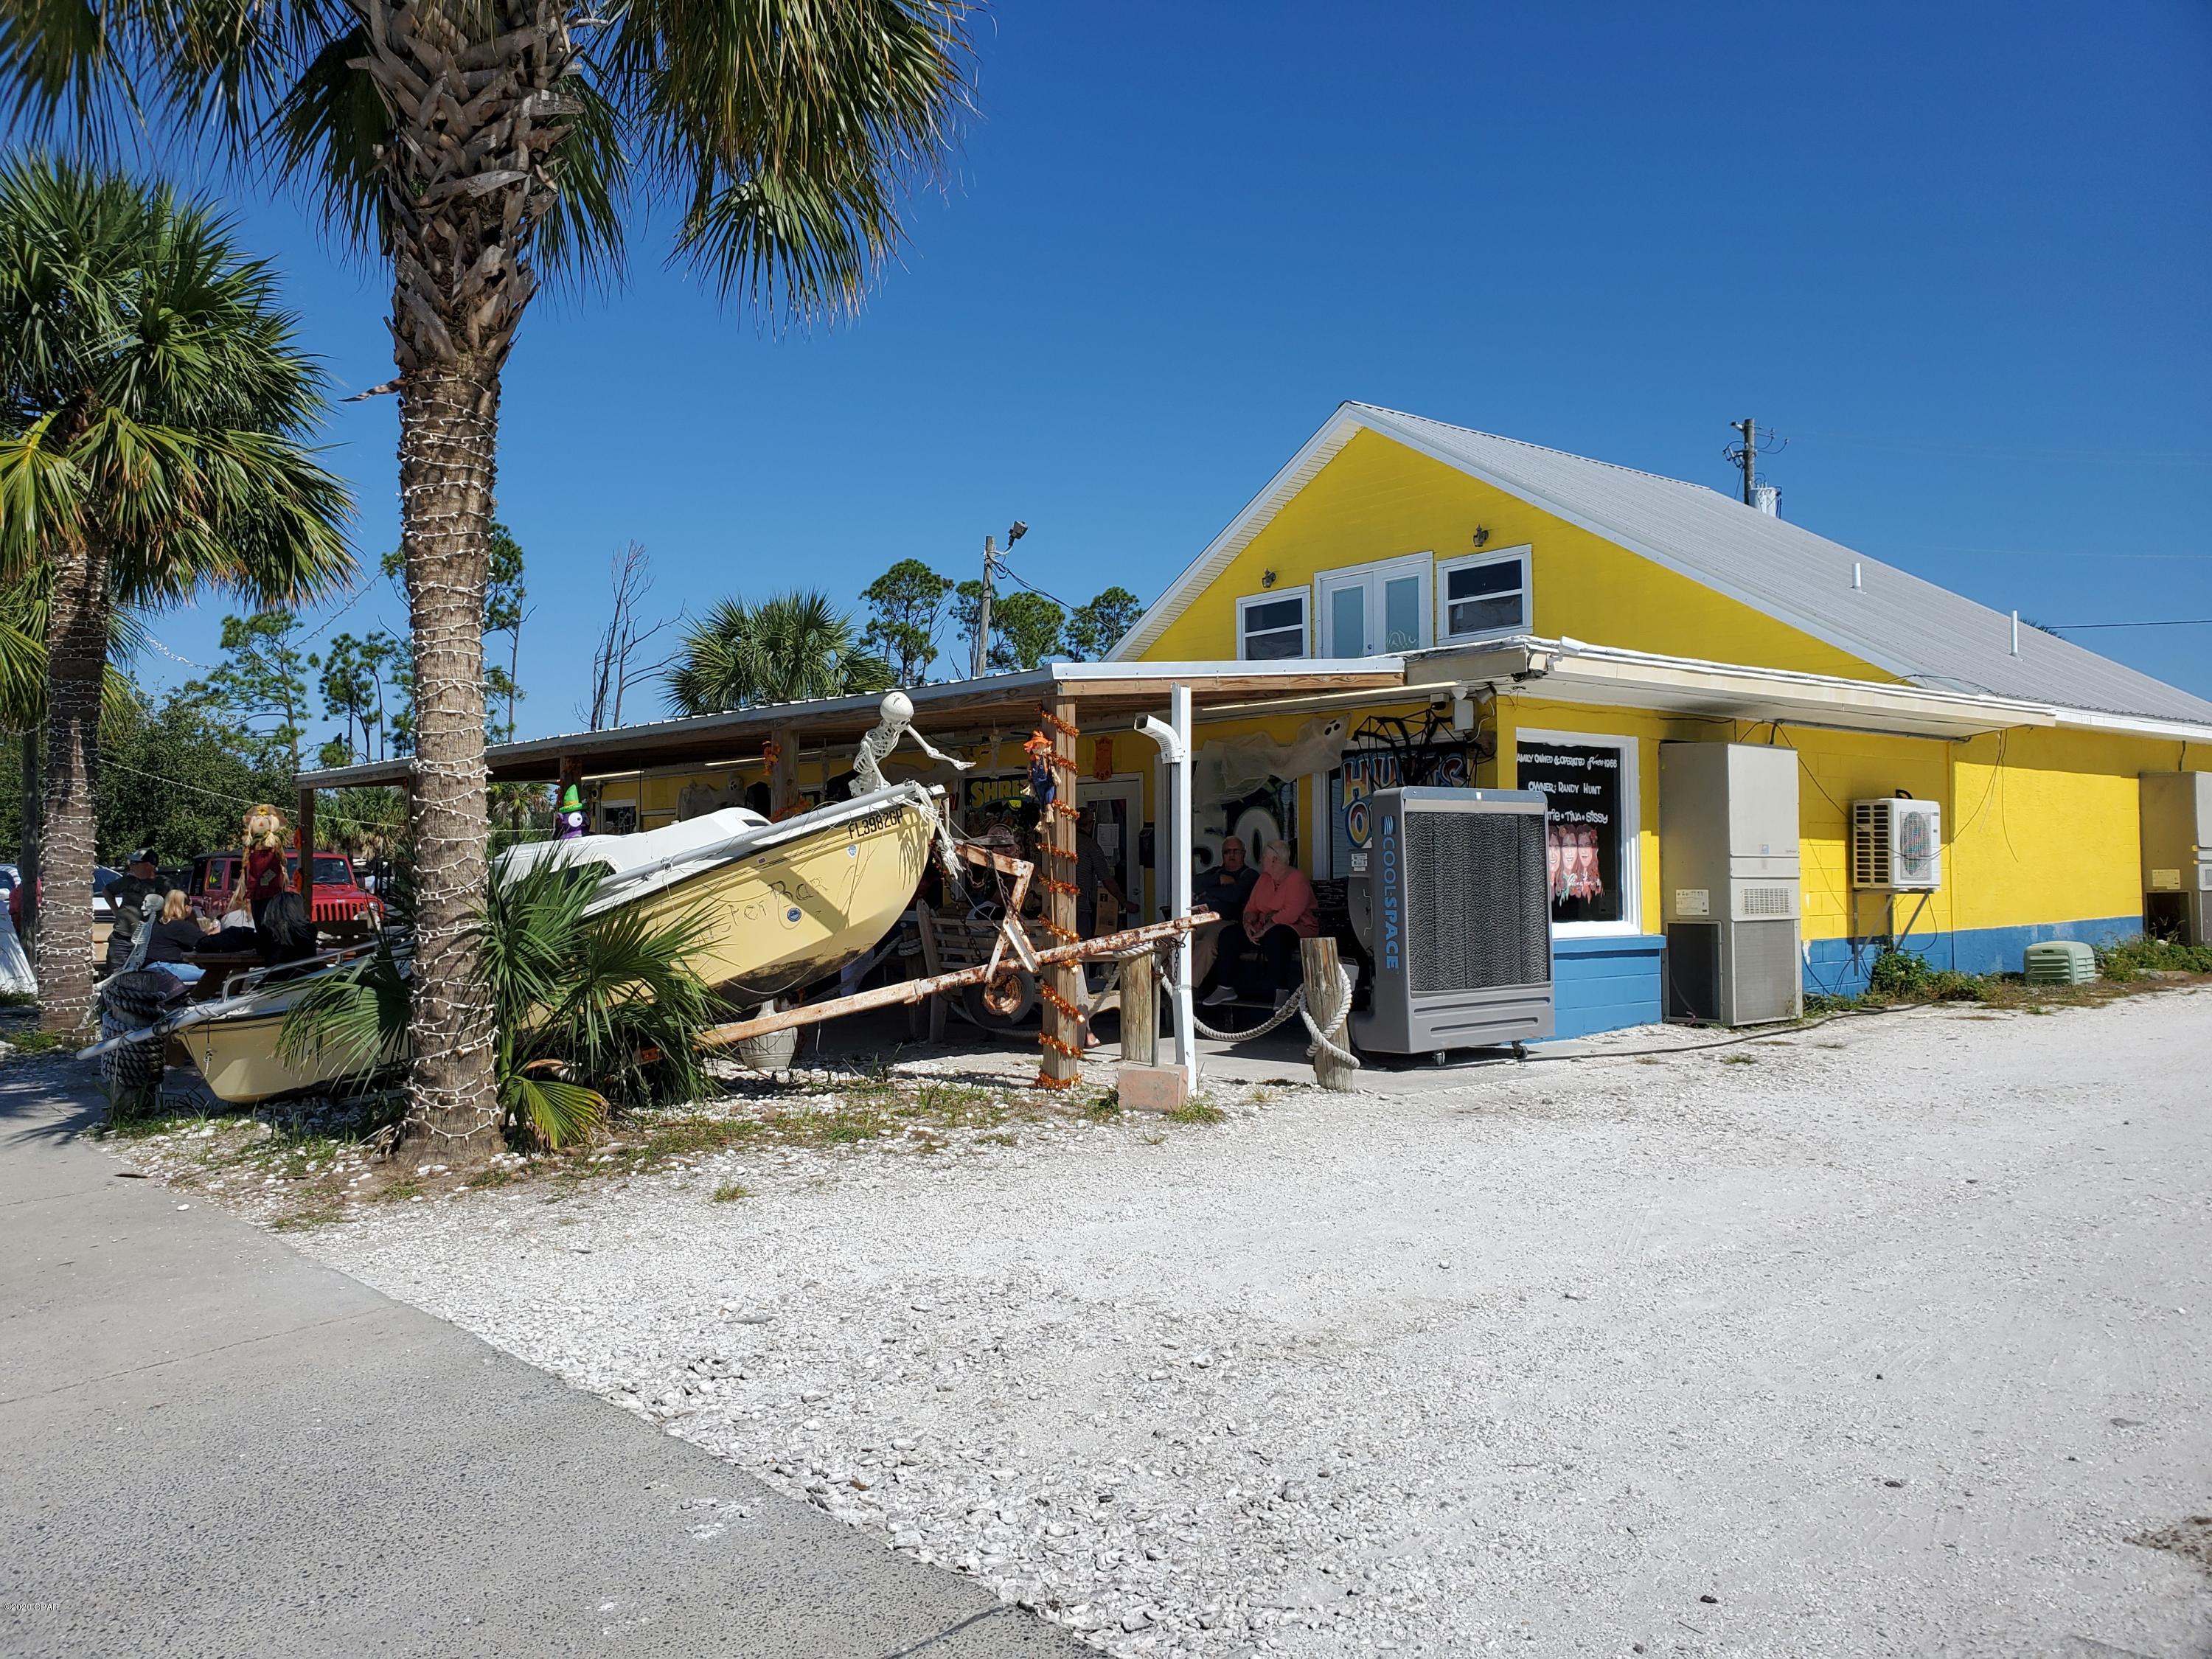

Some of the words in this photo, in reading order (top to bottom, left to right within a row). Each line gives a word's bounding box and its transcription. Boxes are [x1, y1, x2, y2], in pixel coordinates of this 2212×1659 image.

[1517, 753, 1534, 763] AMILY
[1534, 753, 1554, 764] OWNED
[1560, 756, 1585, 767] OPERATED
[1558, 782, 1579, 793] RANDY
[1583, 783, 1601, 795] HUNT
